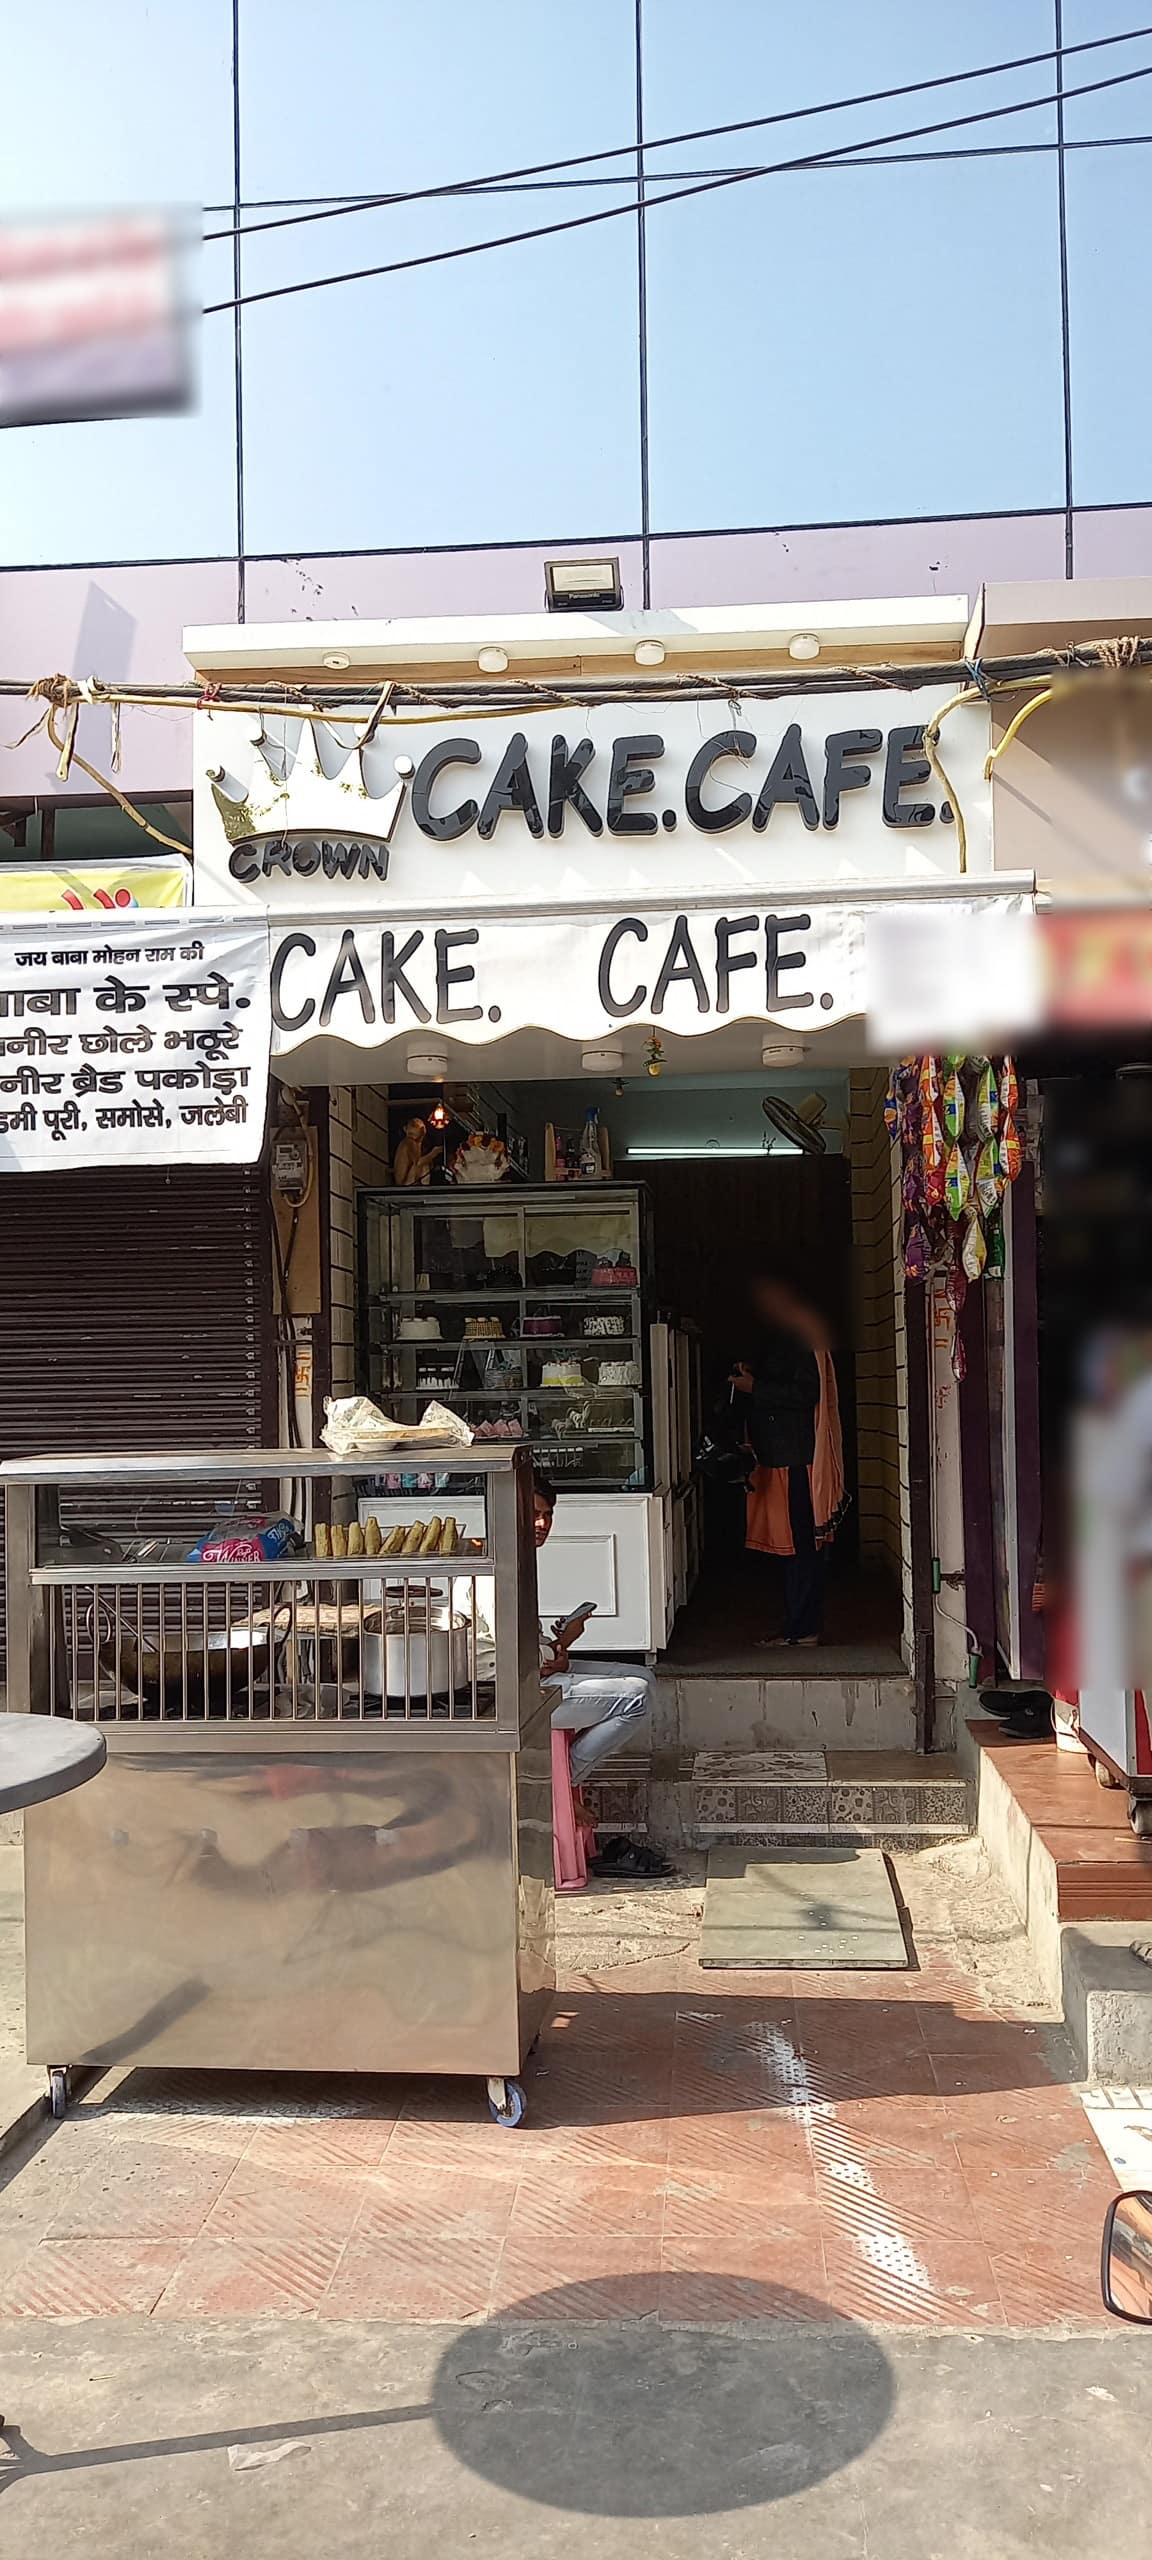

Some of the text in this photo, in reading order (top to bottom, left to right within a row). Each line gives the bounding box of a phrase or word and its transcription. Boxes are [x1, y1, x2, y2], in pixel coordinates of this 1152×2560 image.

[229, 840, 390, 883] CROWN
[15, 941, 204, 966] जय बाबा मोहन राम की
[270, 914, 834, 1031] CAKE. CAFE.
[93, 975, 150, 1013] के
[162, 971, 251, 1011] स्पे.
[79, 1024, 157, 1054] छोले
[164, 1021, 244, 1060] भठूरे
[71, 1063, 126, 1097] ब्रैड
[135, 1061, 251, 1095] पकोड़ा
[43, 1100, 87, 1141] पूरी,
[96, 1099, 172, 1129] समोसे,
[179, 1095, 248, 1126] जलेबी
